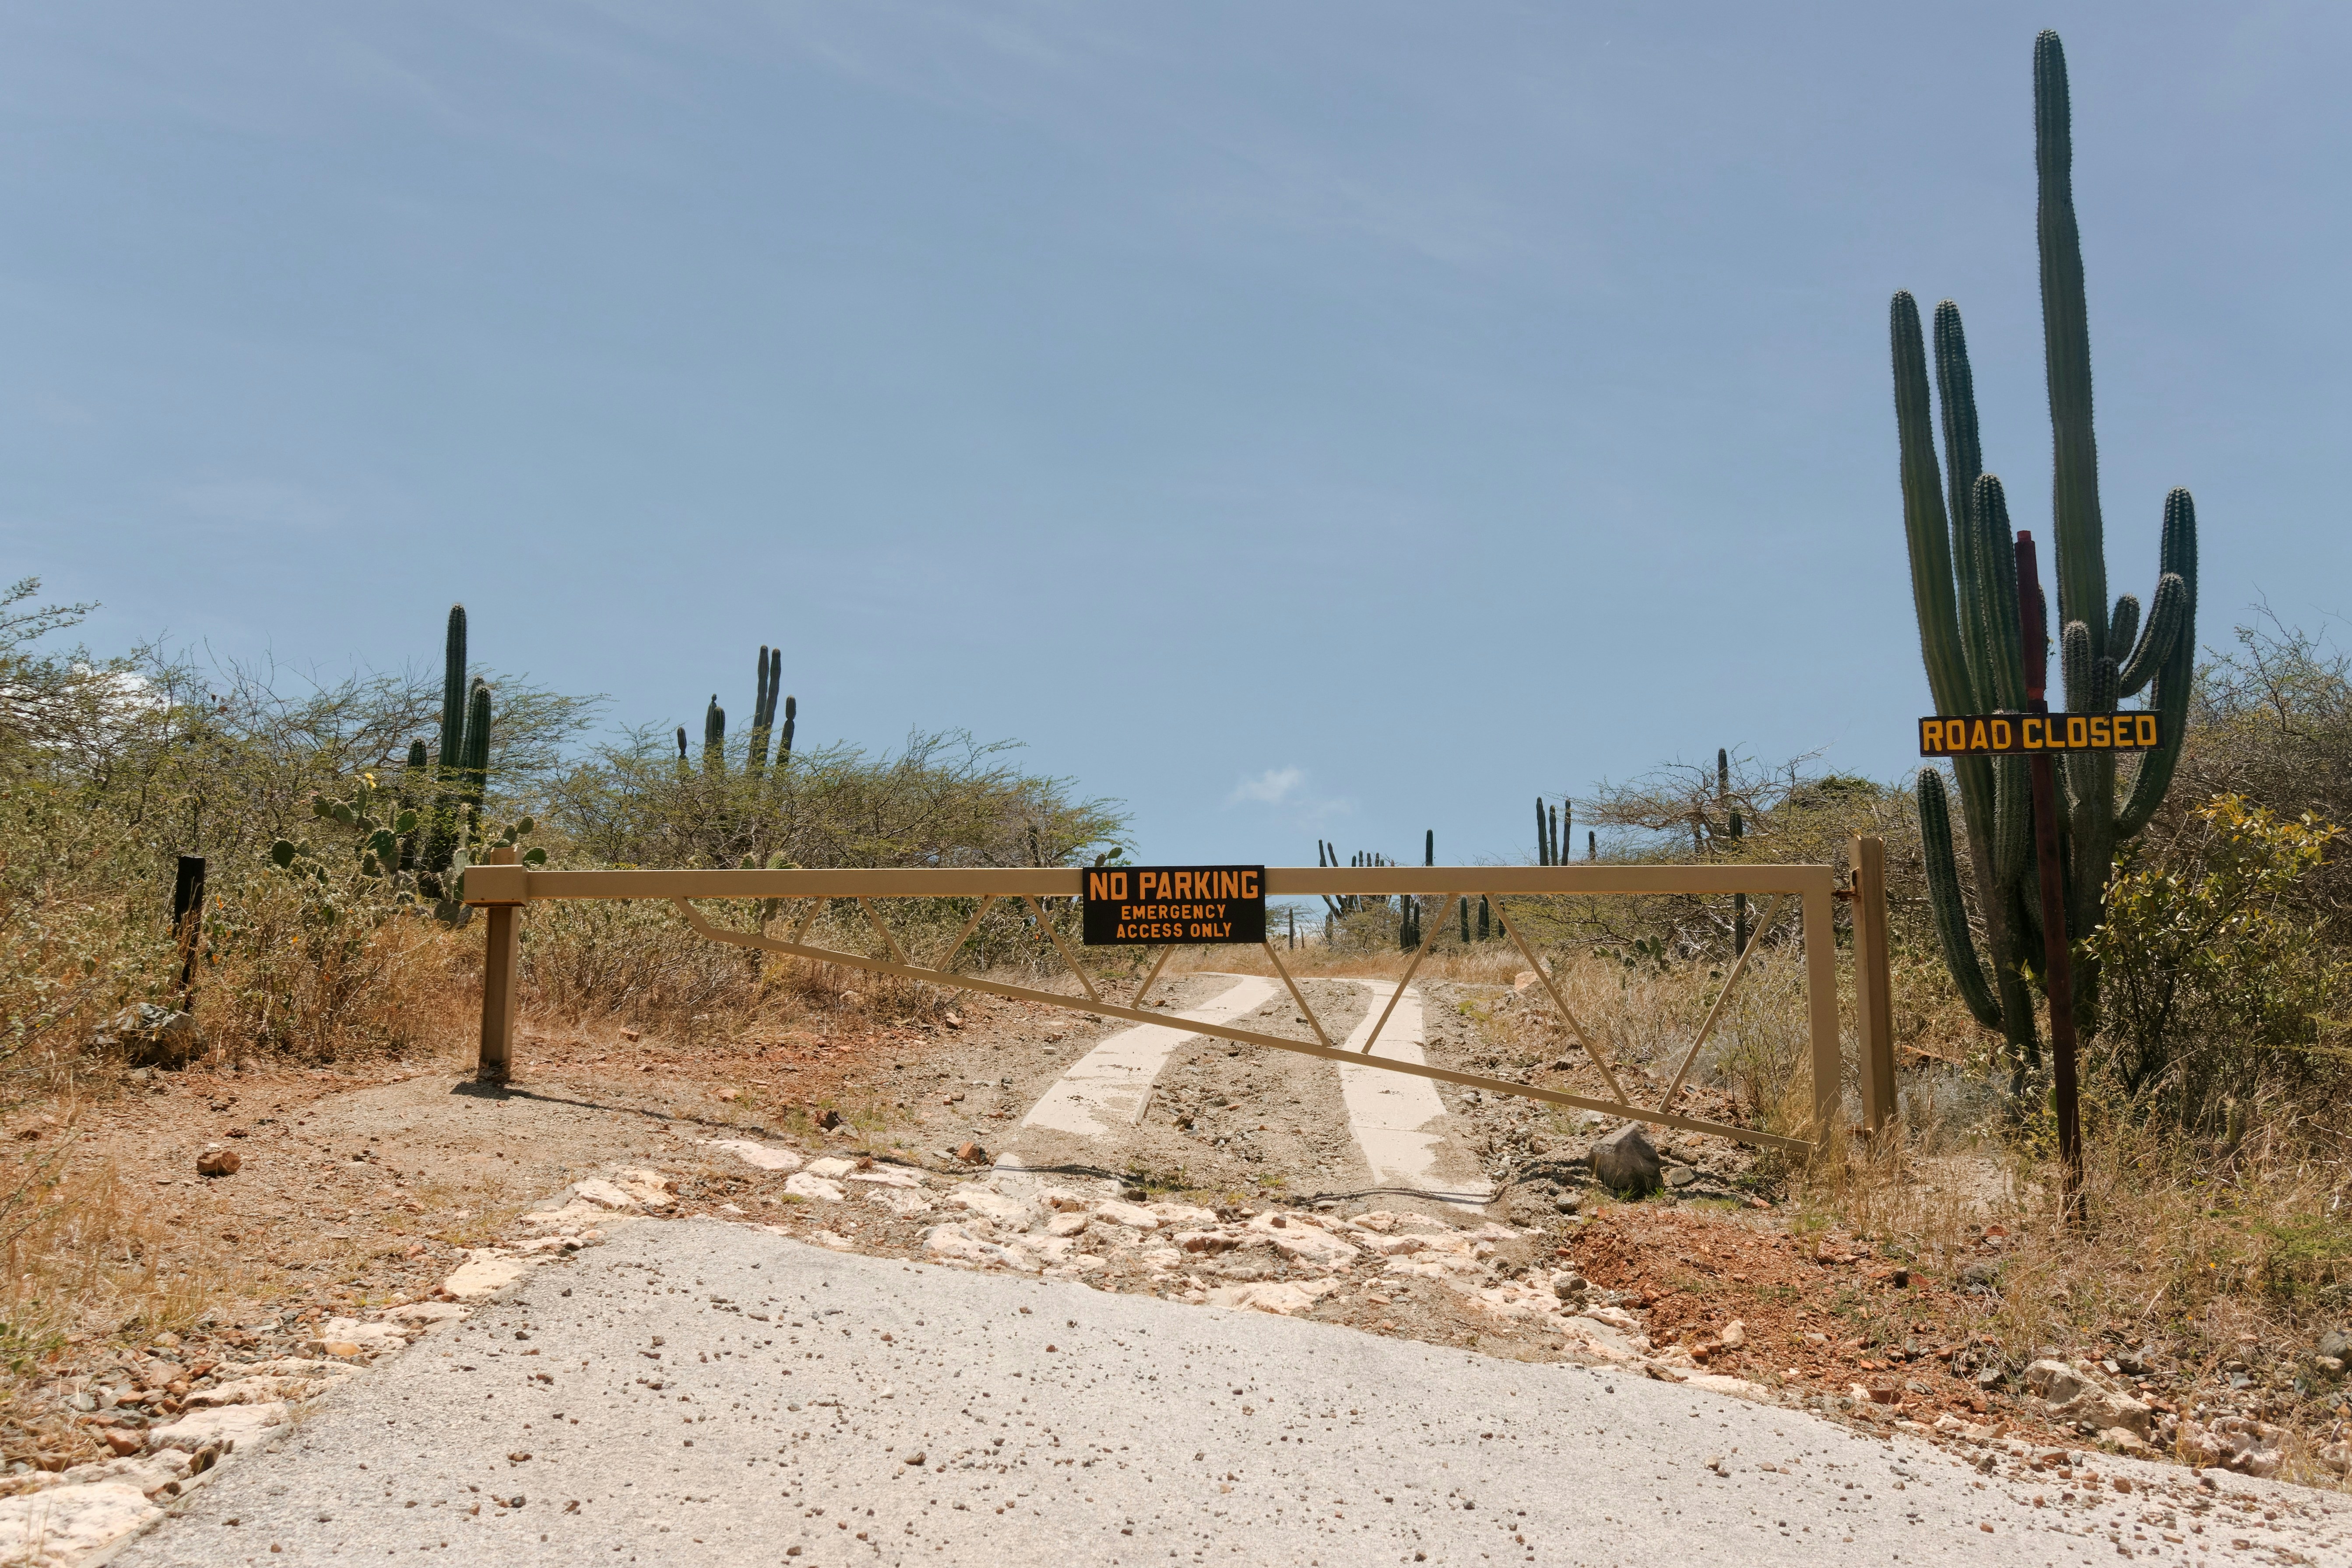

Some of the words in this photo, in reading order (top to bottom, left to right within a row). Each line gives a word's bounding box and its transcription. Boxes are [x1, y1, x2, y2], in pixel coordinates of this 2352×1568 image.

[1923, 719, 2011, 751] ROAD
[2022, 715, 2157, 749] CLOSED
[1090, 872, 1128, 900] NO
[1139, 871, 1258, 900] PARKING
[1122, 904, 1226, 920] EMERGENCY
[1117, 923, 1183, 938] ACCESS
[1190, 922, 1232, 937] ONLY
